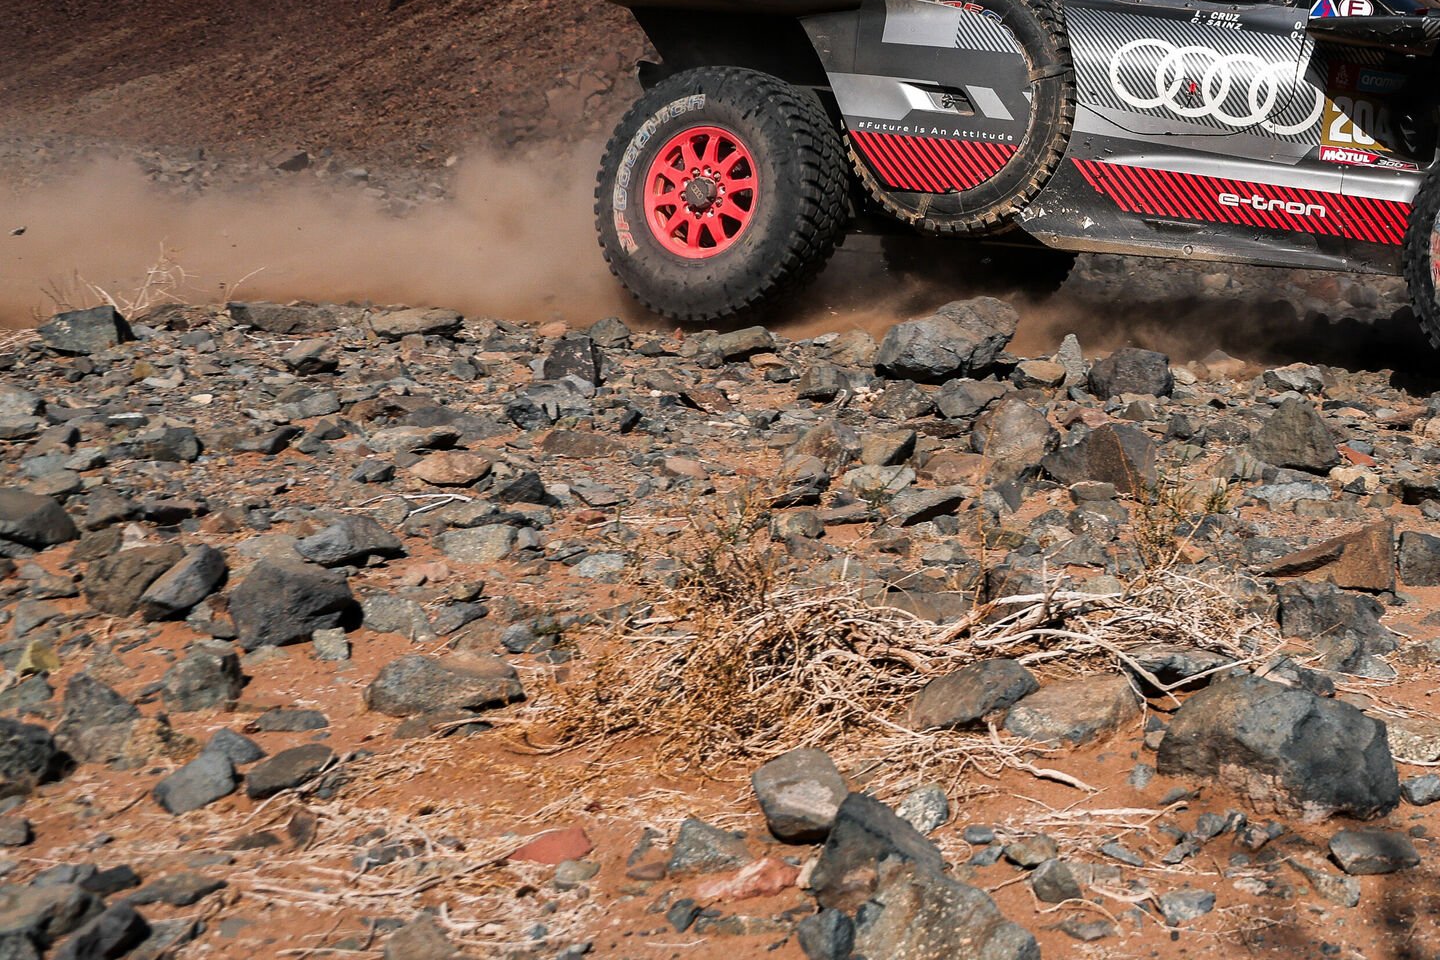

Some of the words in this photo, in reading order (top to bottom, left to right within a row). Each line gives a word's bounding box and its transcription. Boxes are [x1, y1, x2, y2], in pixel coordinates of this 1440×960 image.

[1194, 10, 1206, 19] L.
[1210, 11, 1241, 23] CRUZ
[1206, 19, 1243, 30] SAINZ
[858, 121, 909, 132] #Future
[931, 127, 947, 135] An
[952, 129, 1013, 141] Attitude
[1322, 149, 1371, 163] MOTUL
[1218, 192, 1326, 218] e-tron
